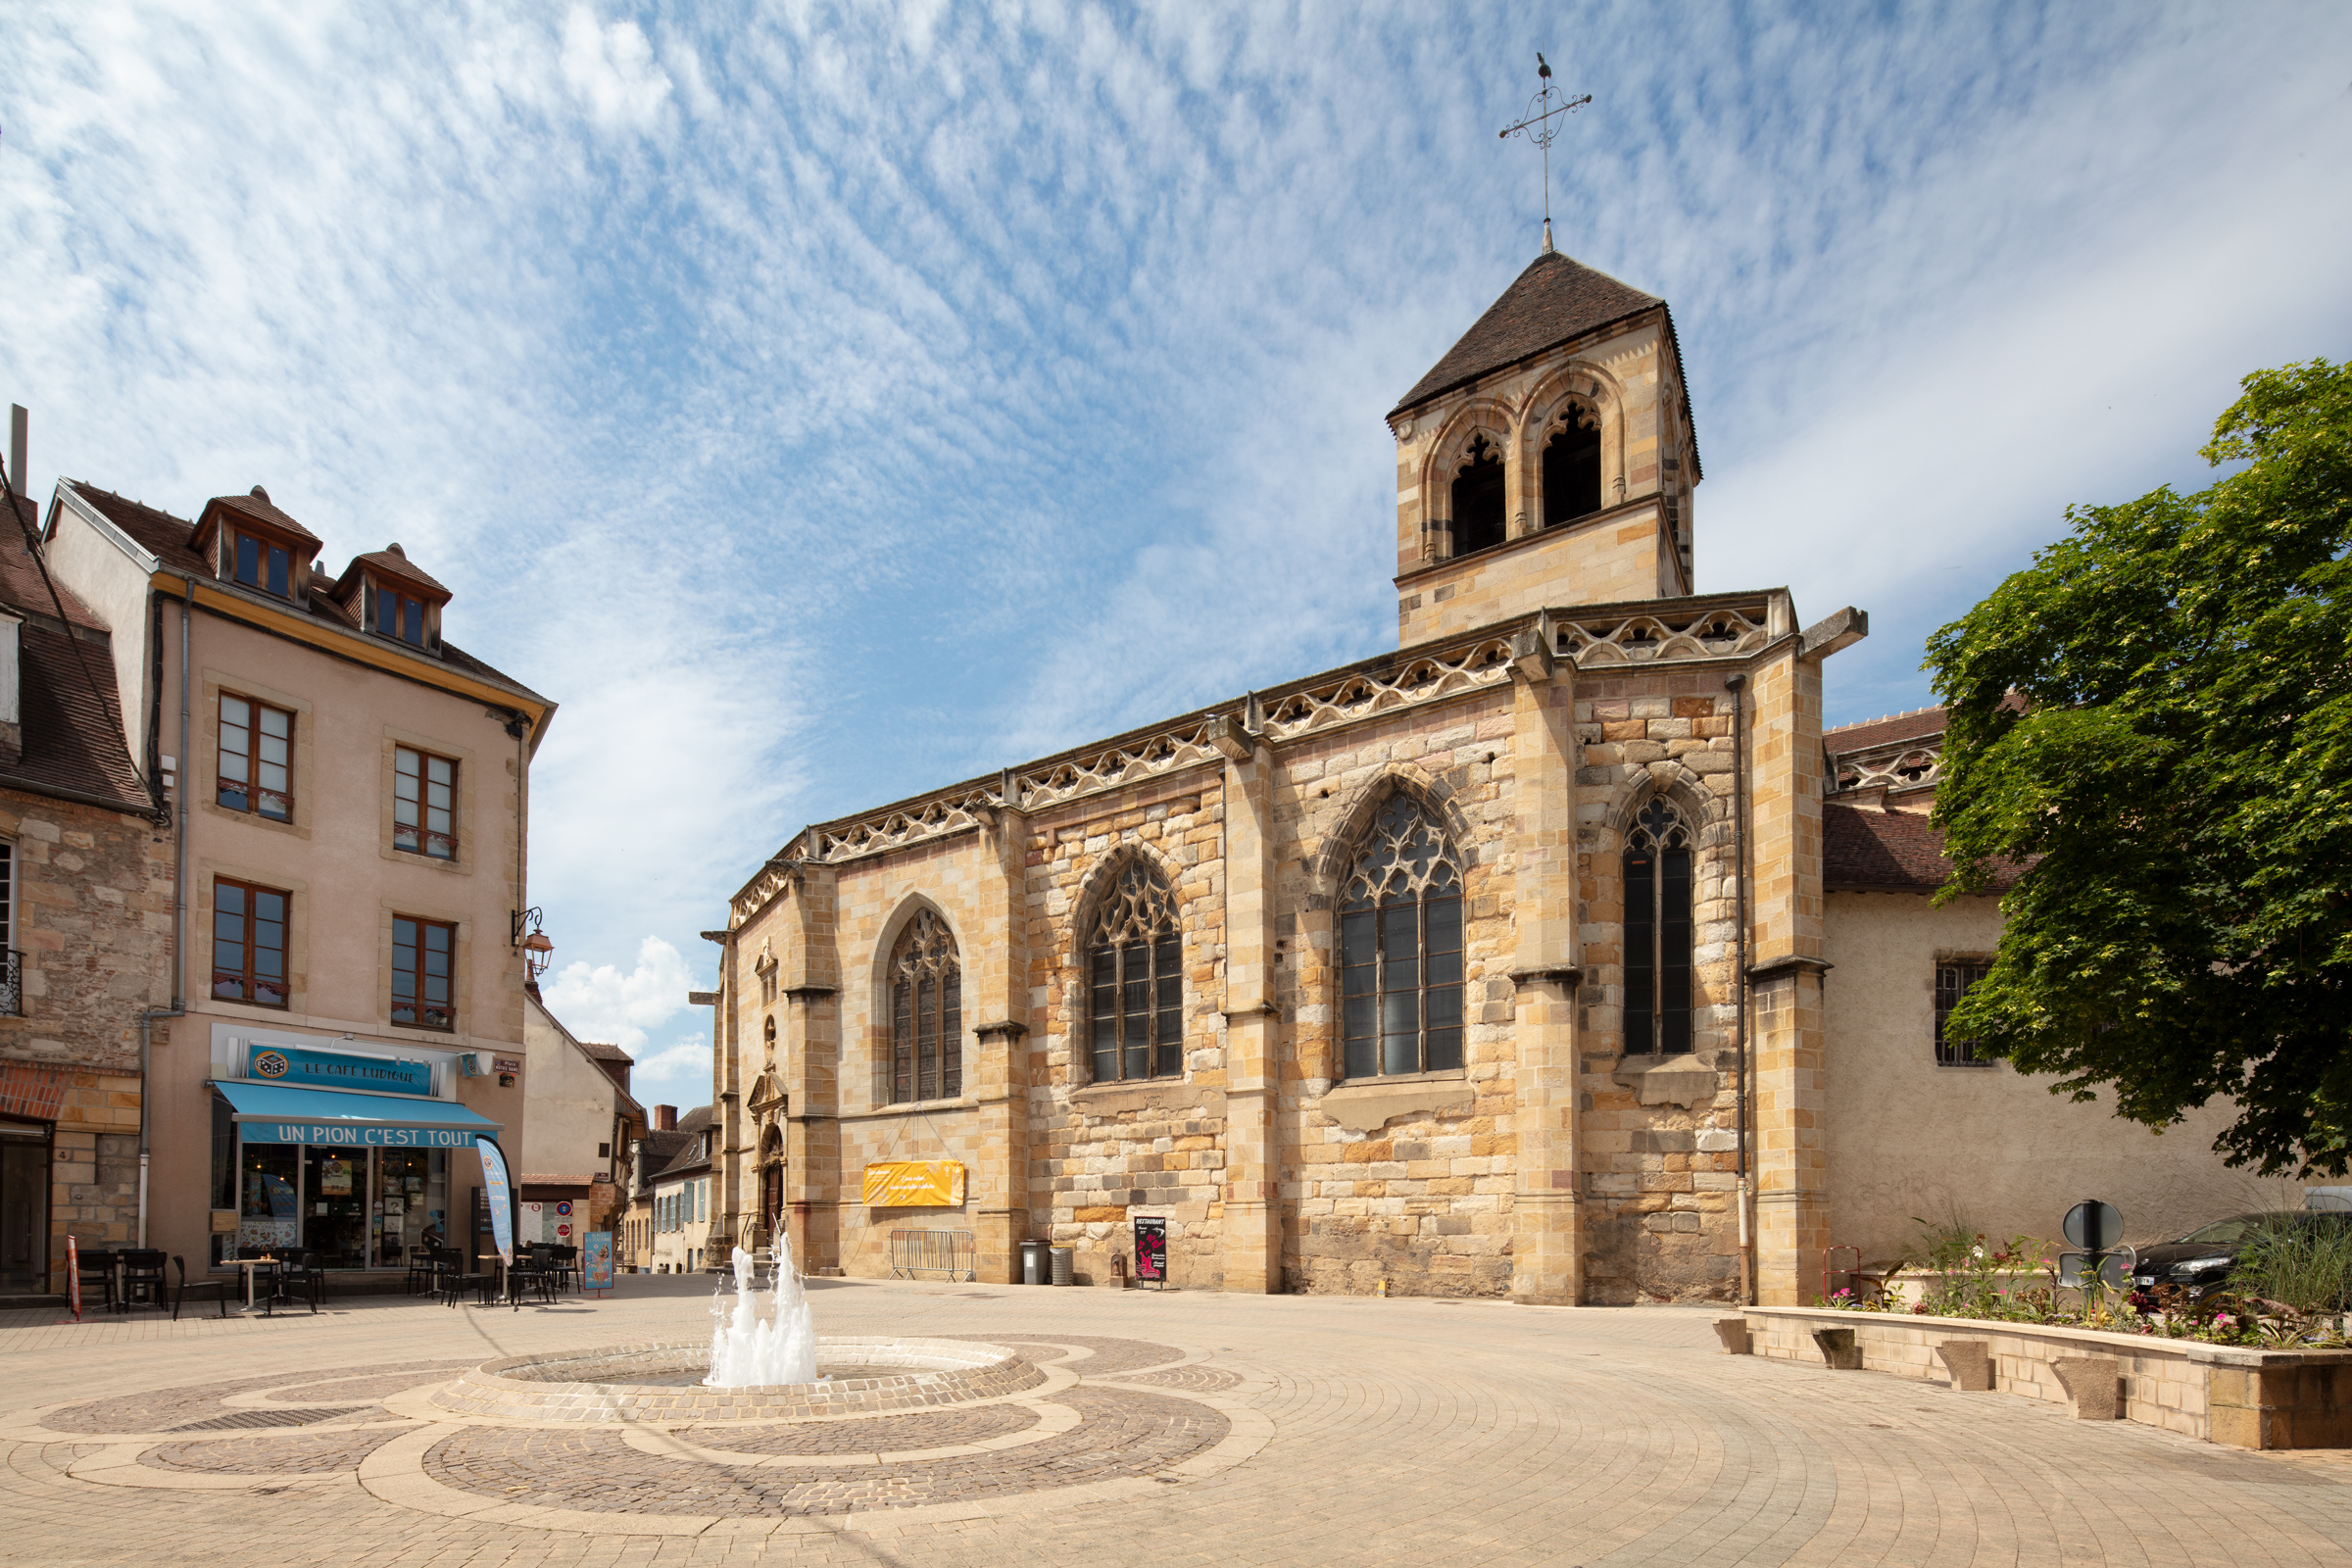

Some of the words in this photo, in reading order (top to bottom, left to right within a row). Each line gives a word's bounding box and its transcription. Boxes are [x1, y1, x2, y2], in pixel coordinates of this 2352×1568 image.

[305, 1063, 320, 1074] LE
[326, 1064, 357, 1077] CAFÉ
[363, 1067, 414, 1083] LUDIQUE
[278, 1125, 304, 1142] UN
[313, 1127, 357, 1144] PION
[365, 1129, 418, 1145] C'EST
[427, 1130, 471, 1147] TOUT
